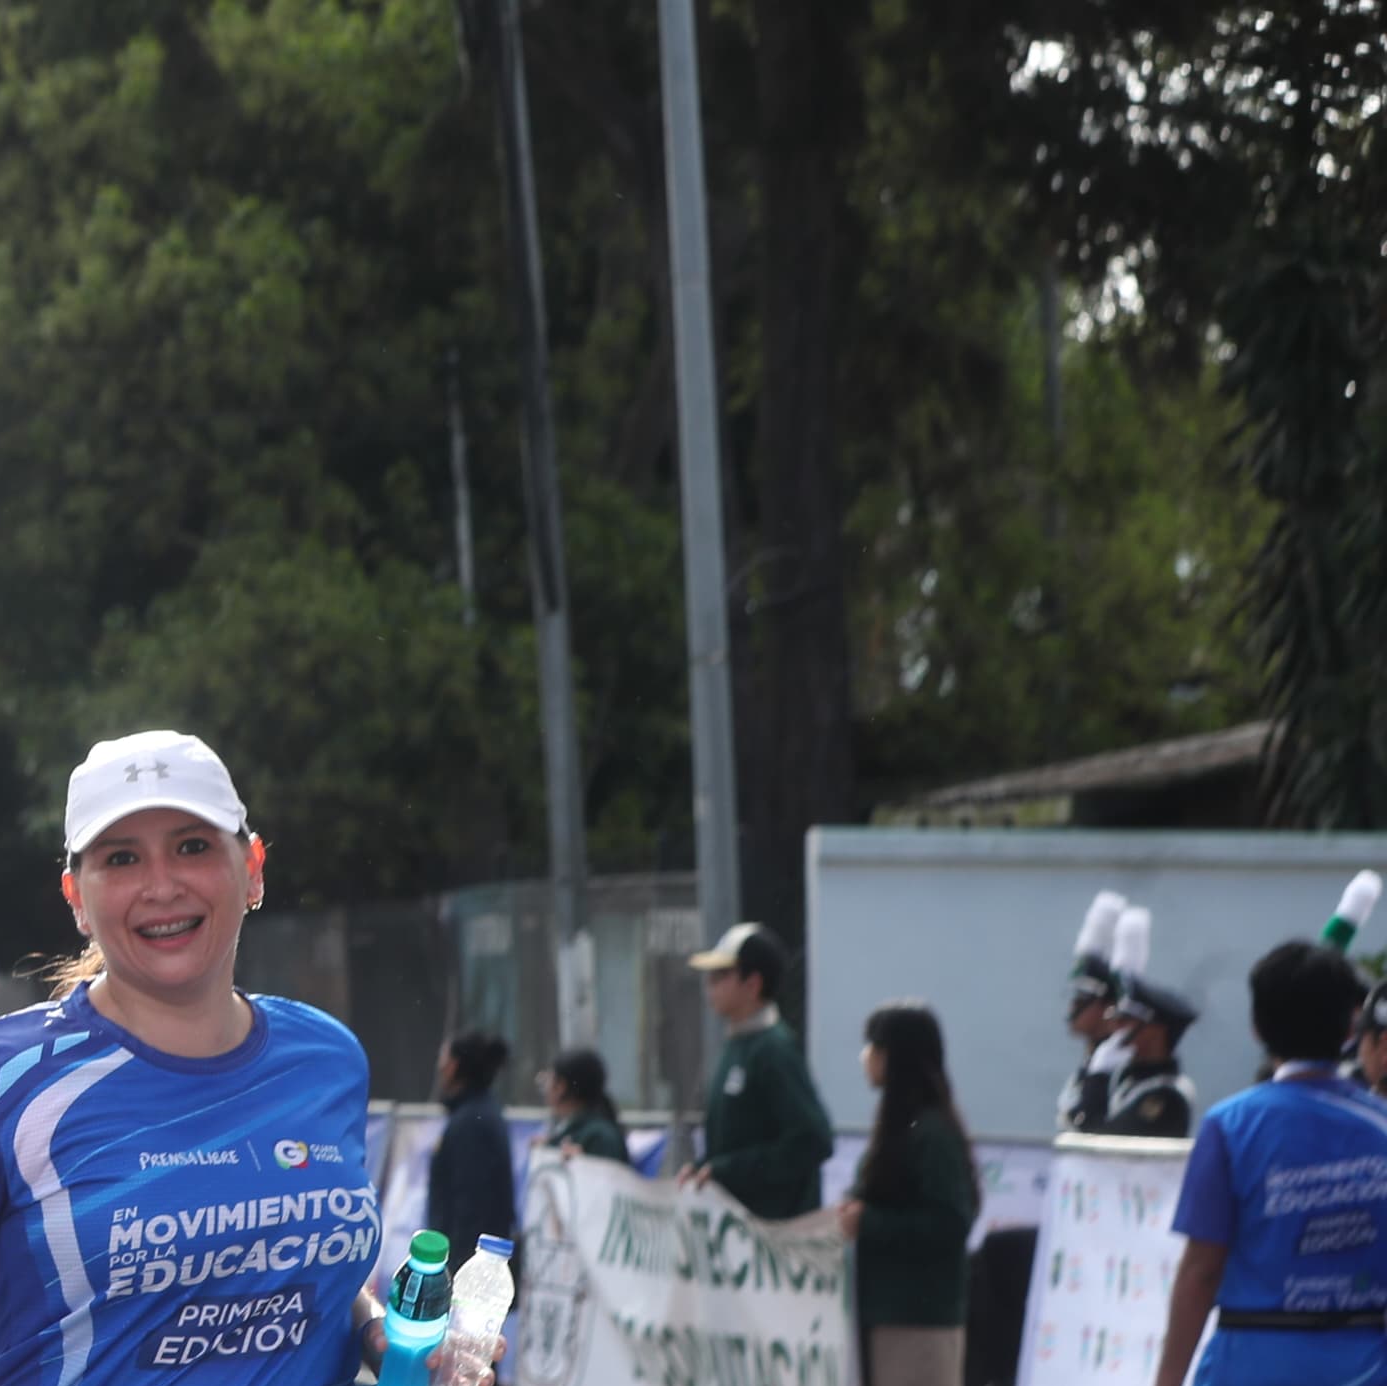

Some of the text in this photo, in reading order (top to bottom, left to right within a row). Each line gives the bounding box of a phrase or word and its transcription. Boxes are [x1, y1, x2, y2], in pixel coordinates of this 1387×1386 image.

[108, 1187, 353, 1255] MOVIMIENTO
[113, 1206, 138, 1224] EN
[106, 1223, 374, 1300] EDUCACIÓN
[109, 1244, 176, 1268] POR LA
[177, 1292, 304, 1328] PRIMERA
